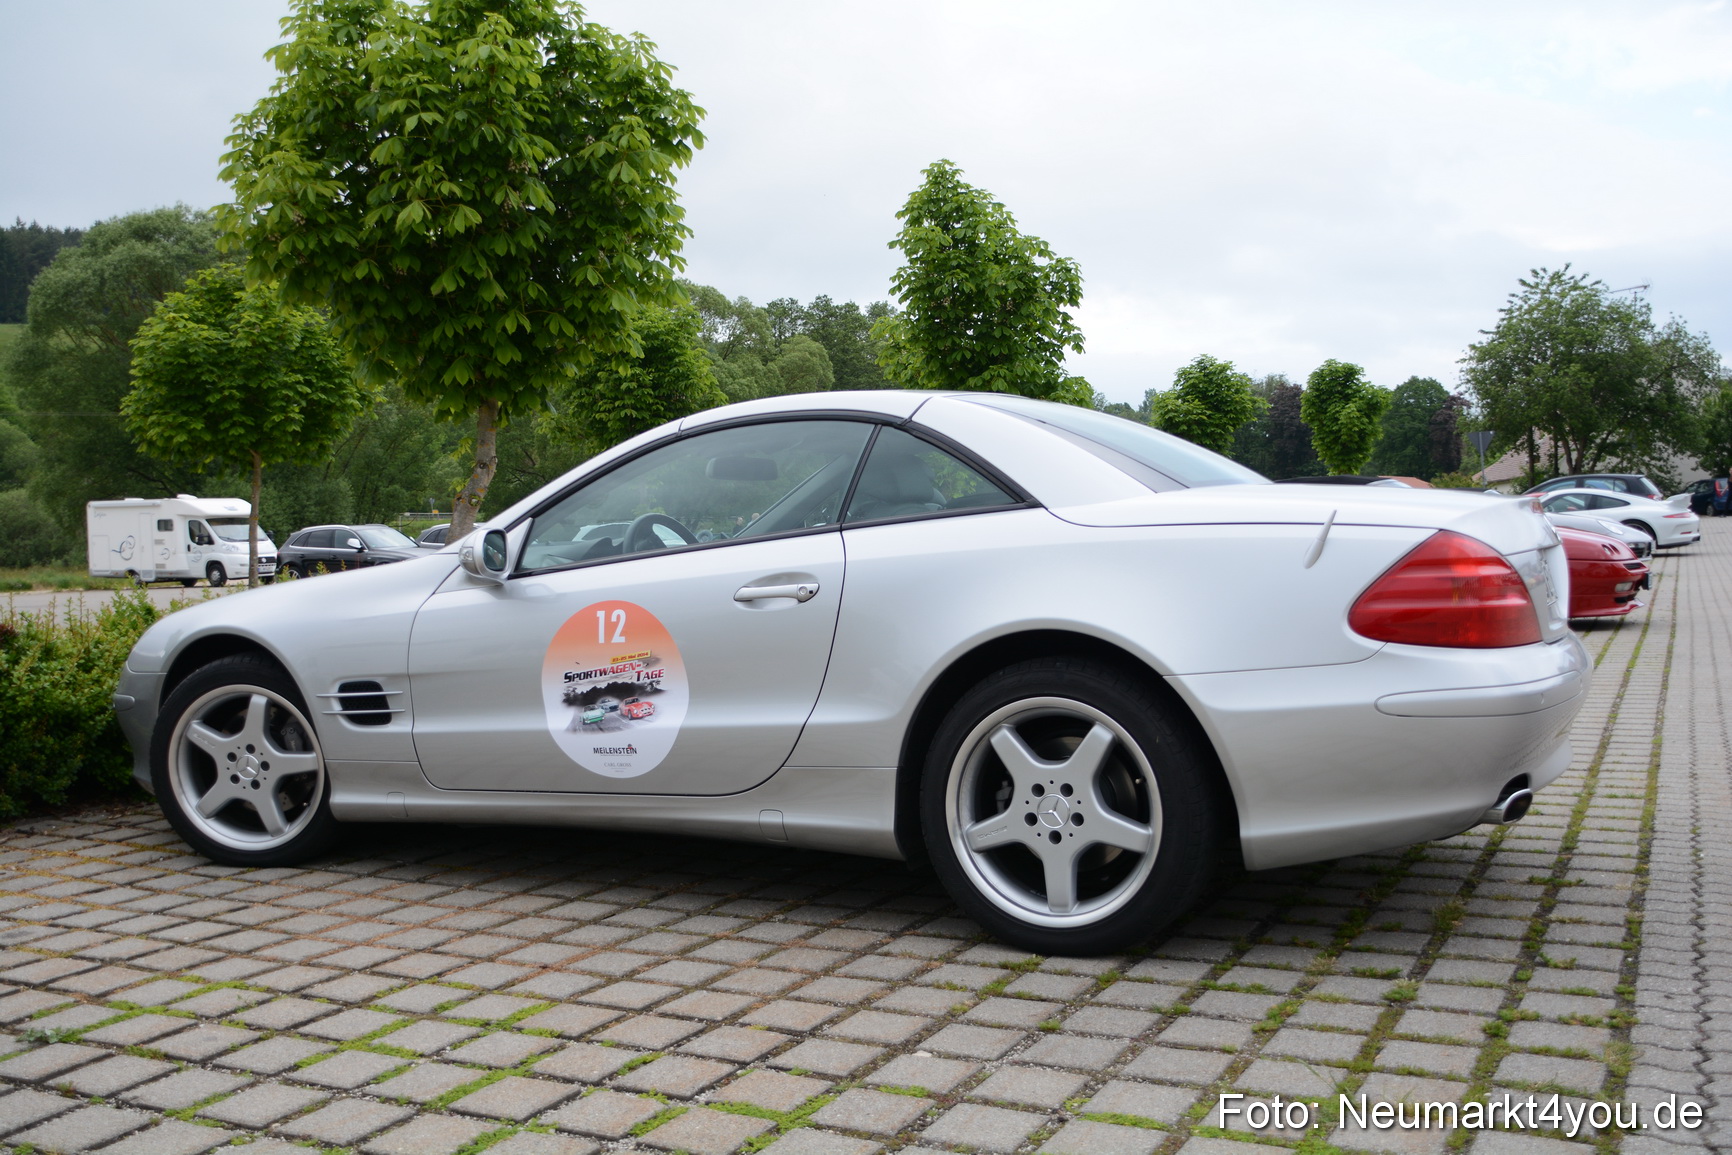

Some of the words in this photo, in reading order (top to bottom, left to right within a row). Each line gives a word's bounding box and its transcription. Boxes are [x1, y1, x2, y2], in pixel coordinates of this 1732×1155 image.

[596, 608, 627, 644] 12
[564, 662, 642, 683] SPORTWAGEN-
[635, 668, 665, 682] TAGE
[593, 746, 638, 755] MEILENSTEIN
